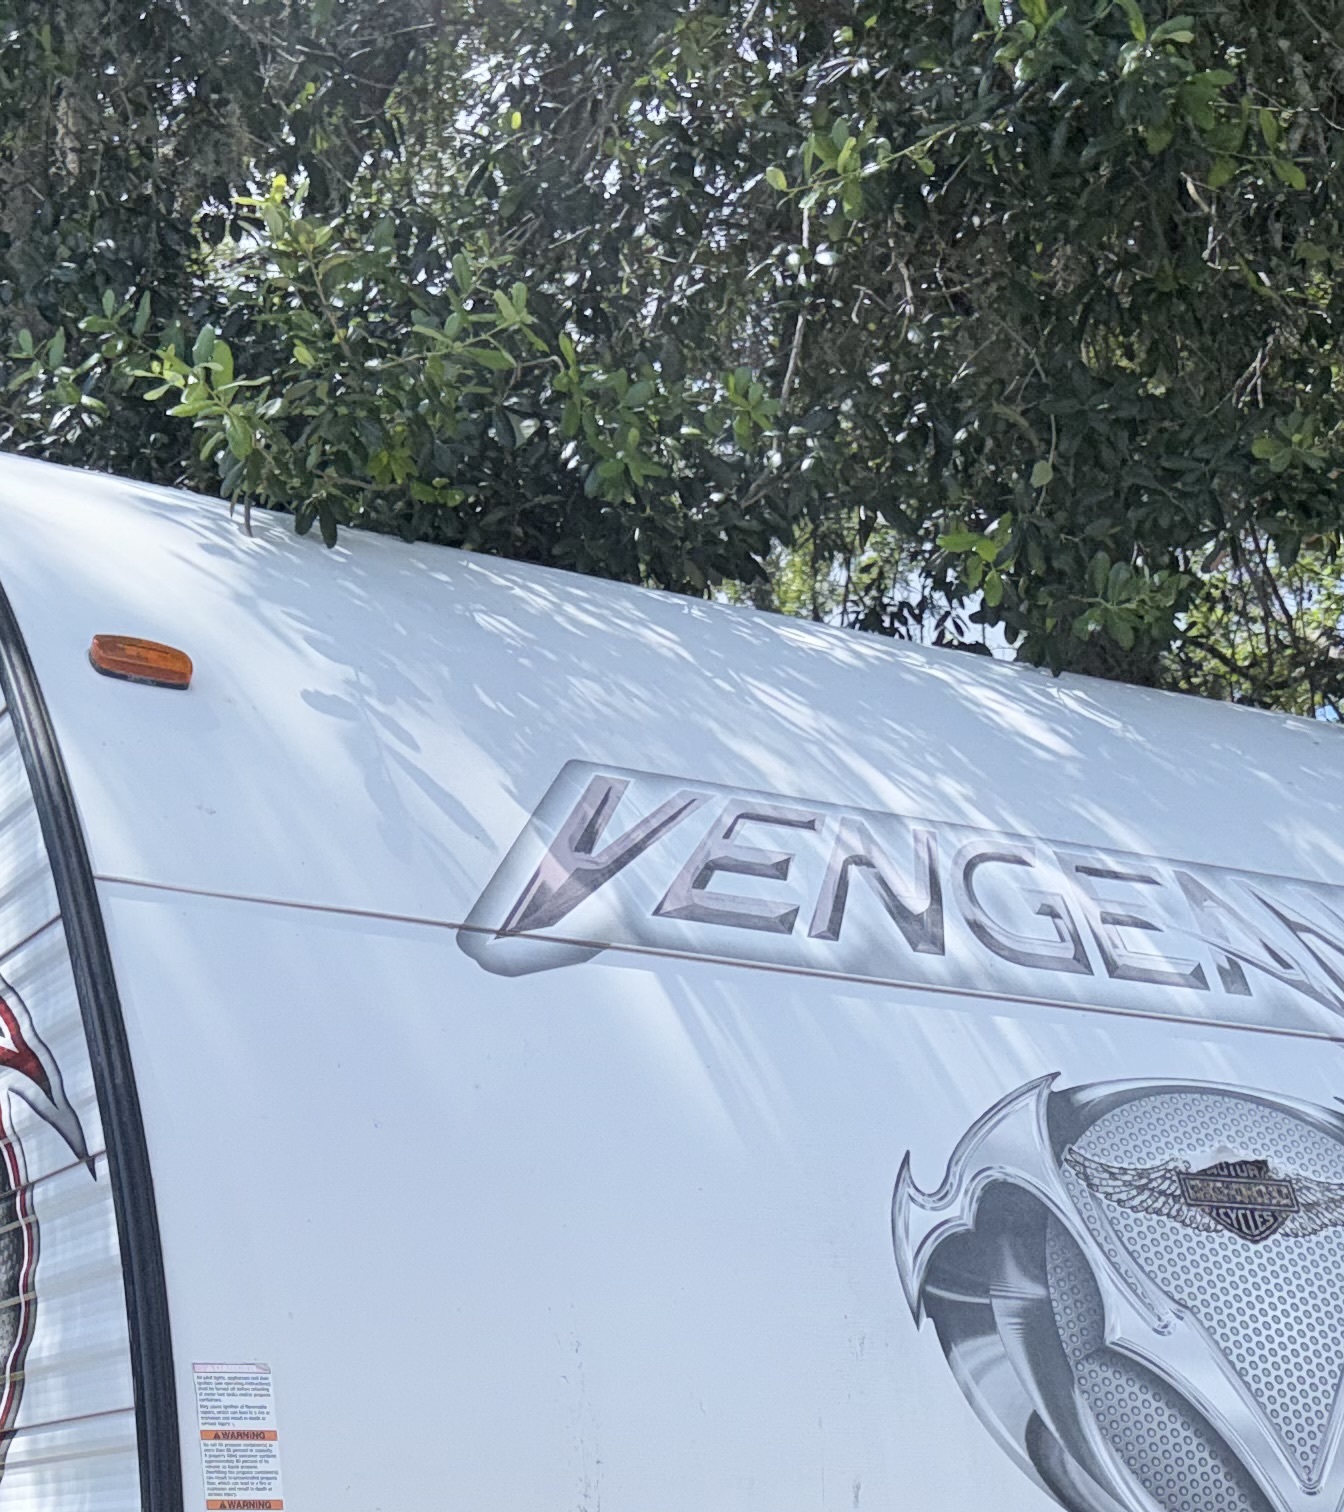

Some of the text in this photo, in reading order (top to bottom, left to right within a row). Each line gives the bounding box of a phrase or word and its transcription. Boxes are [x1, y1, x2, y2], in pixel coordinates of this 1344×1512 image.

[1219, 1208, 1274, 1235] CYCLES
[221, 1431, 265, 1440] WARNING
[226, 1500, 272, 1510] WARNING
